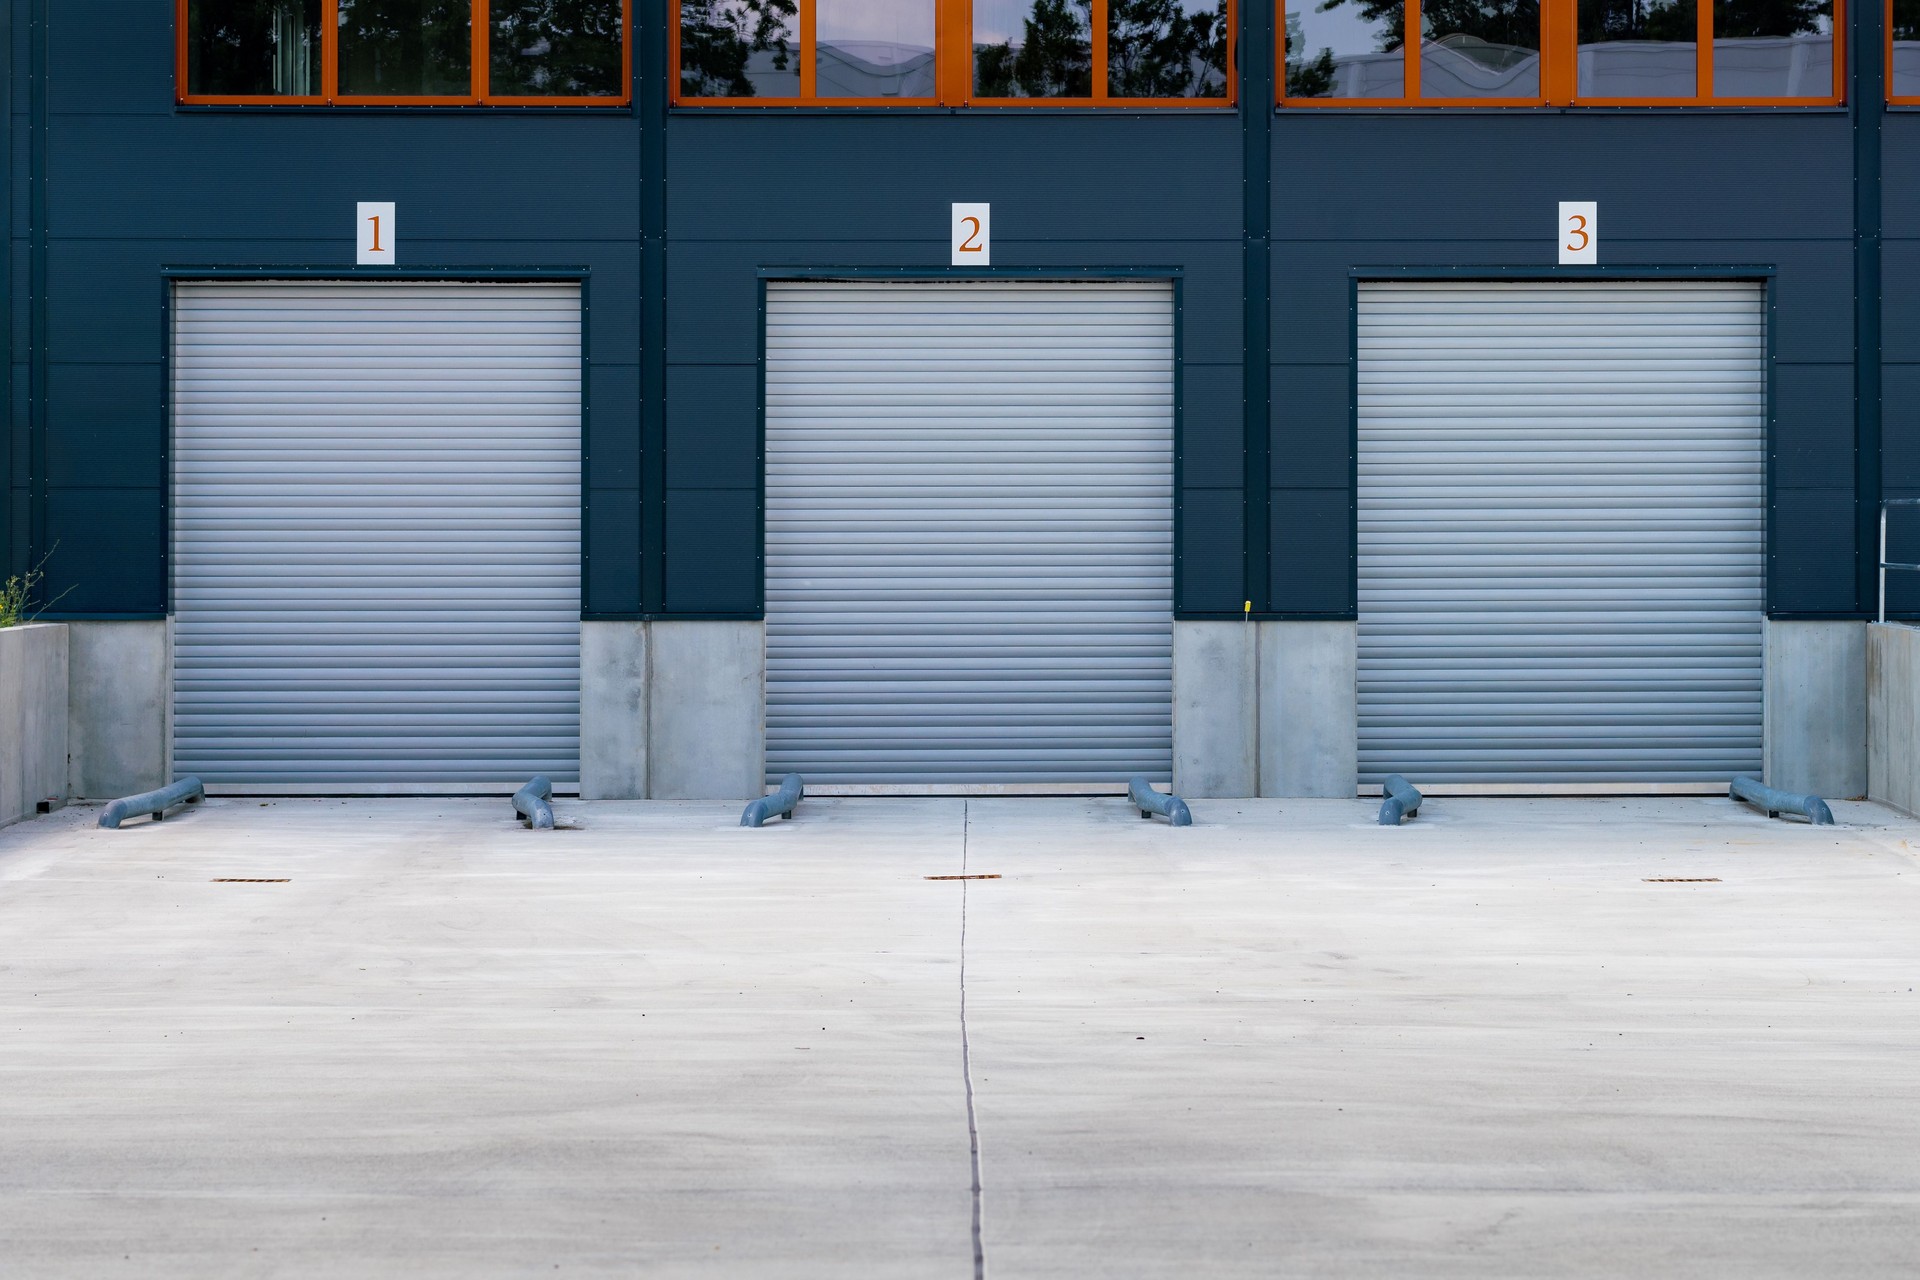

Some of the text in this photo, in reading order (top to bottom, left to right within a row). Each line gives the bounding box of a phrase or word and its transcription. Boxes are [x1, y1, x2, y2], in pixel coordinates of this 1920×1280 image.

[367, 215, 385, 252] 1
[958, 216, 983, 252] 2
[1566, 214, 1589, 251] 3
